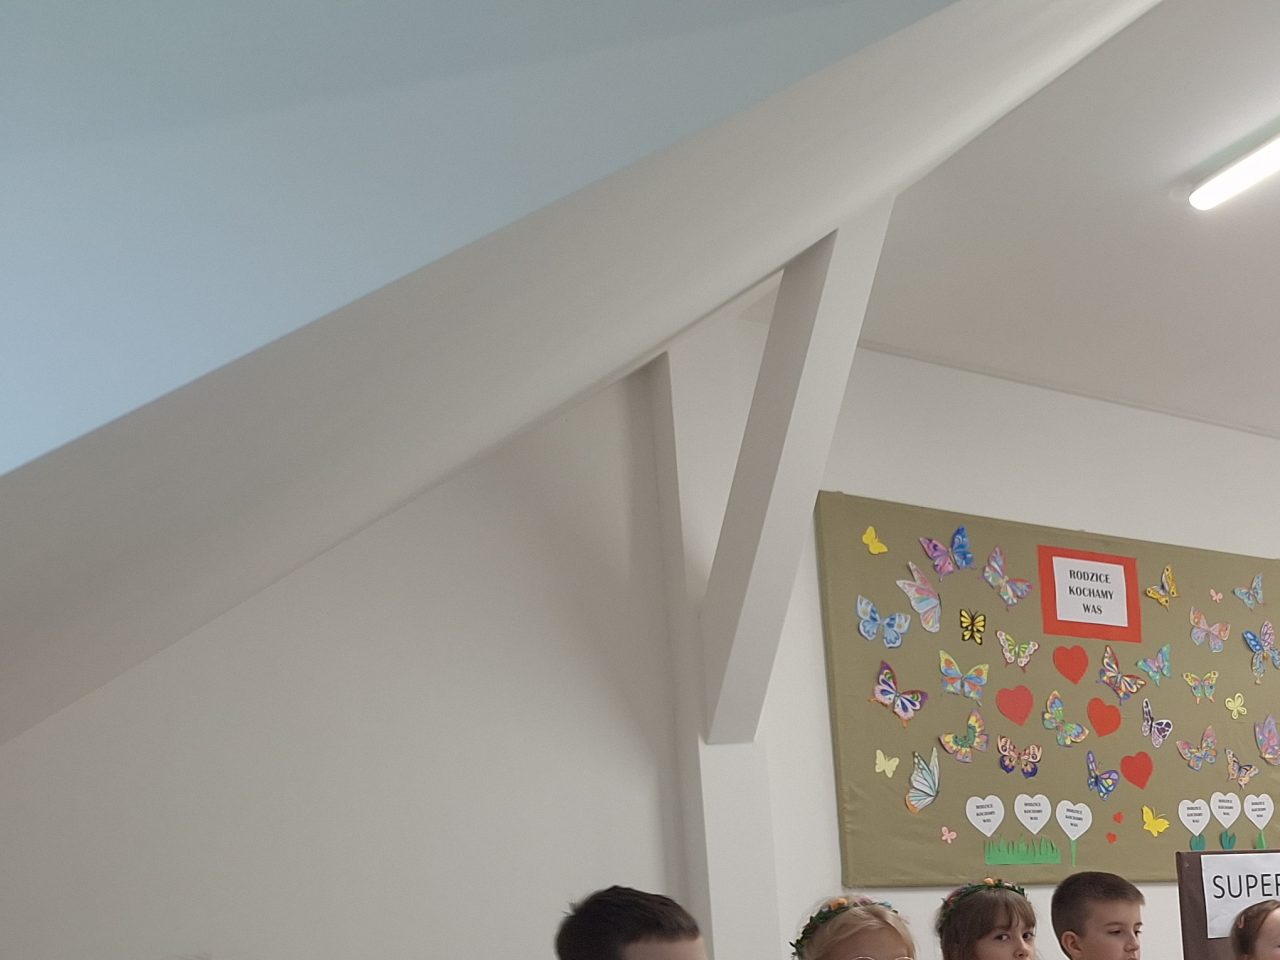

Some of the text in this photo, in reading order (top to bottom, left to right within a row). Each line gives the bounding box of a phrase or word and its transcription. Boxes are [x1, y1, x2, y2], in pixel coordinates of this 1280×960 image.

[1069, 569, 1111, 584] RODZICE
[1068, 585, 1114, 600] KOCHAMY
[1082, 603, 1103, 615] WAS
